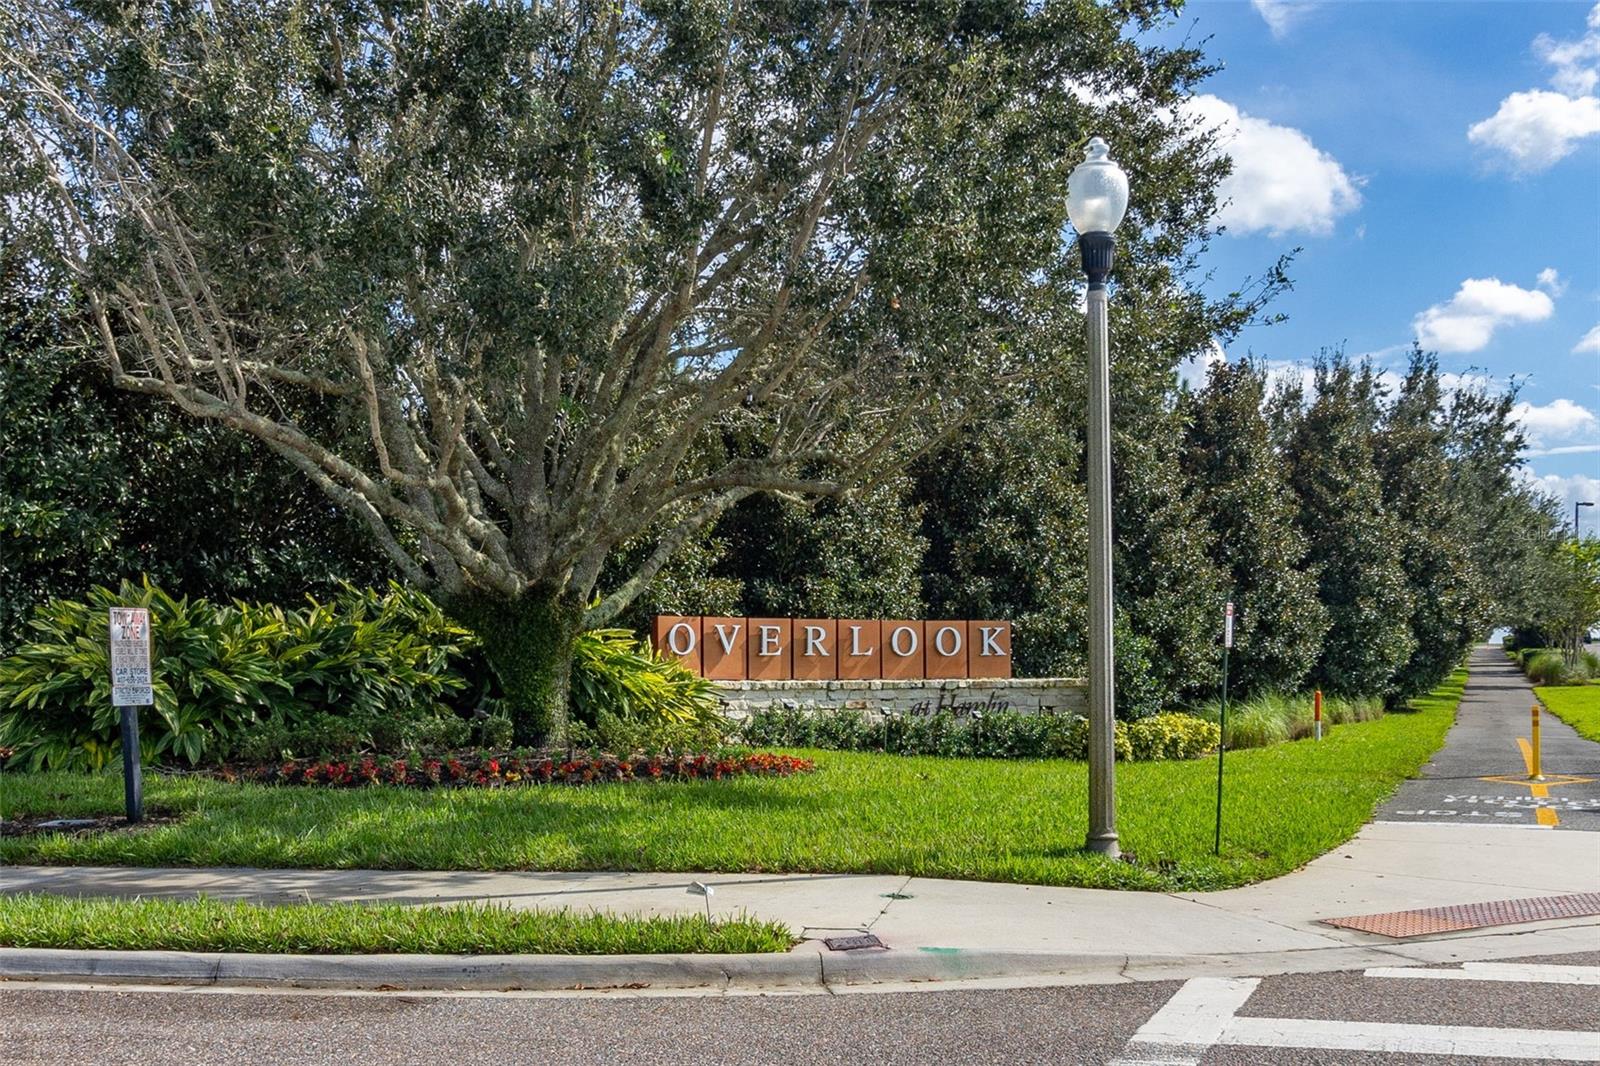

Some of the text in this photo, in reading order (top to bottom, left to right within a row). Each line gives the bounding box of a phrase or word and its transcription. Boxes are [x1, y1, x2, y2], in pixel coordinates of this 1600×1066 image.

[121, 626, 140, 639] ZONE
[668, 622, 1006, 657] OVERLOOK
[910, 700, 932, 716] at
[1395, 808, 1523, 818] STOP
